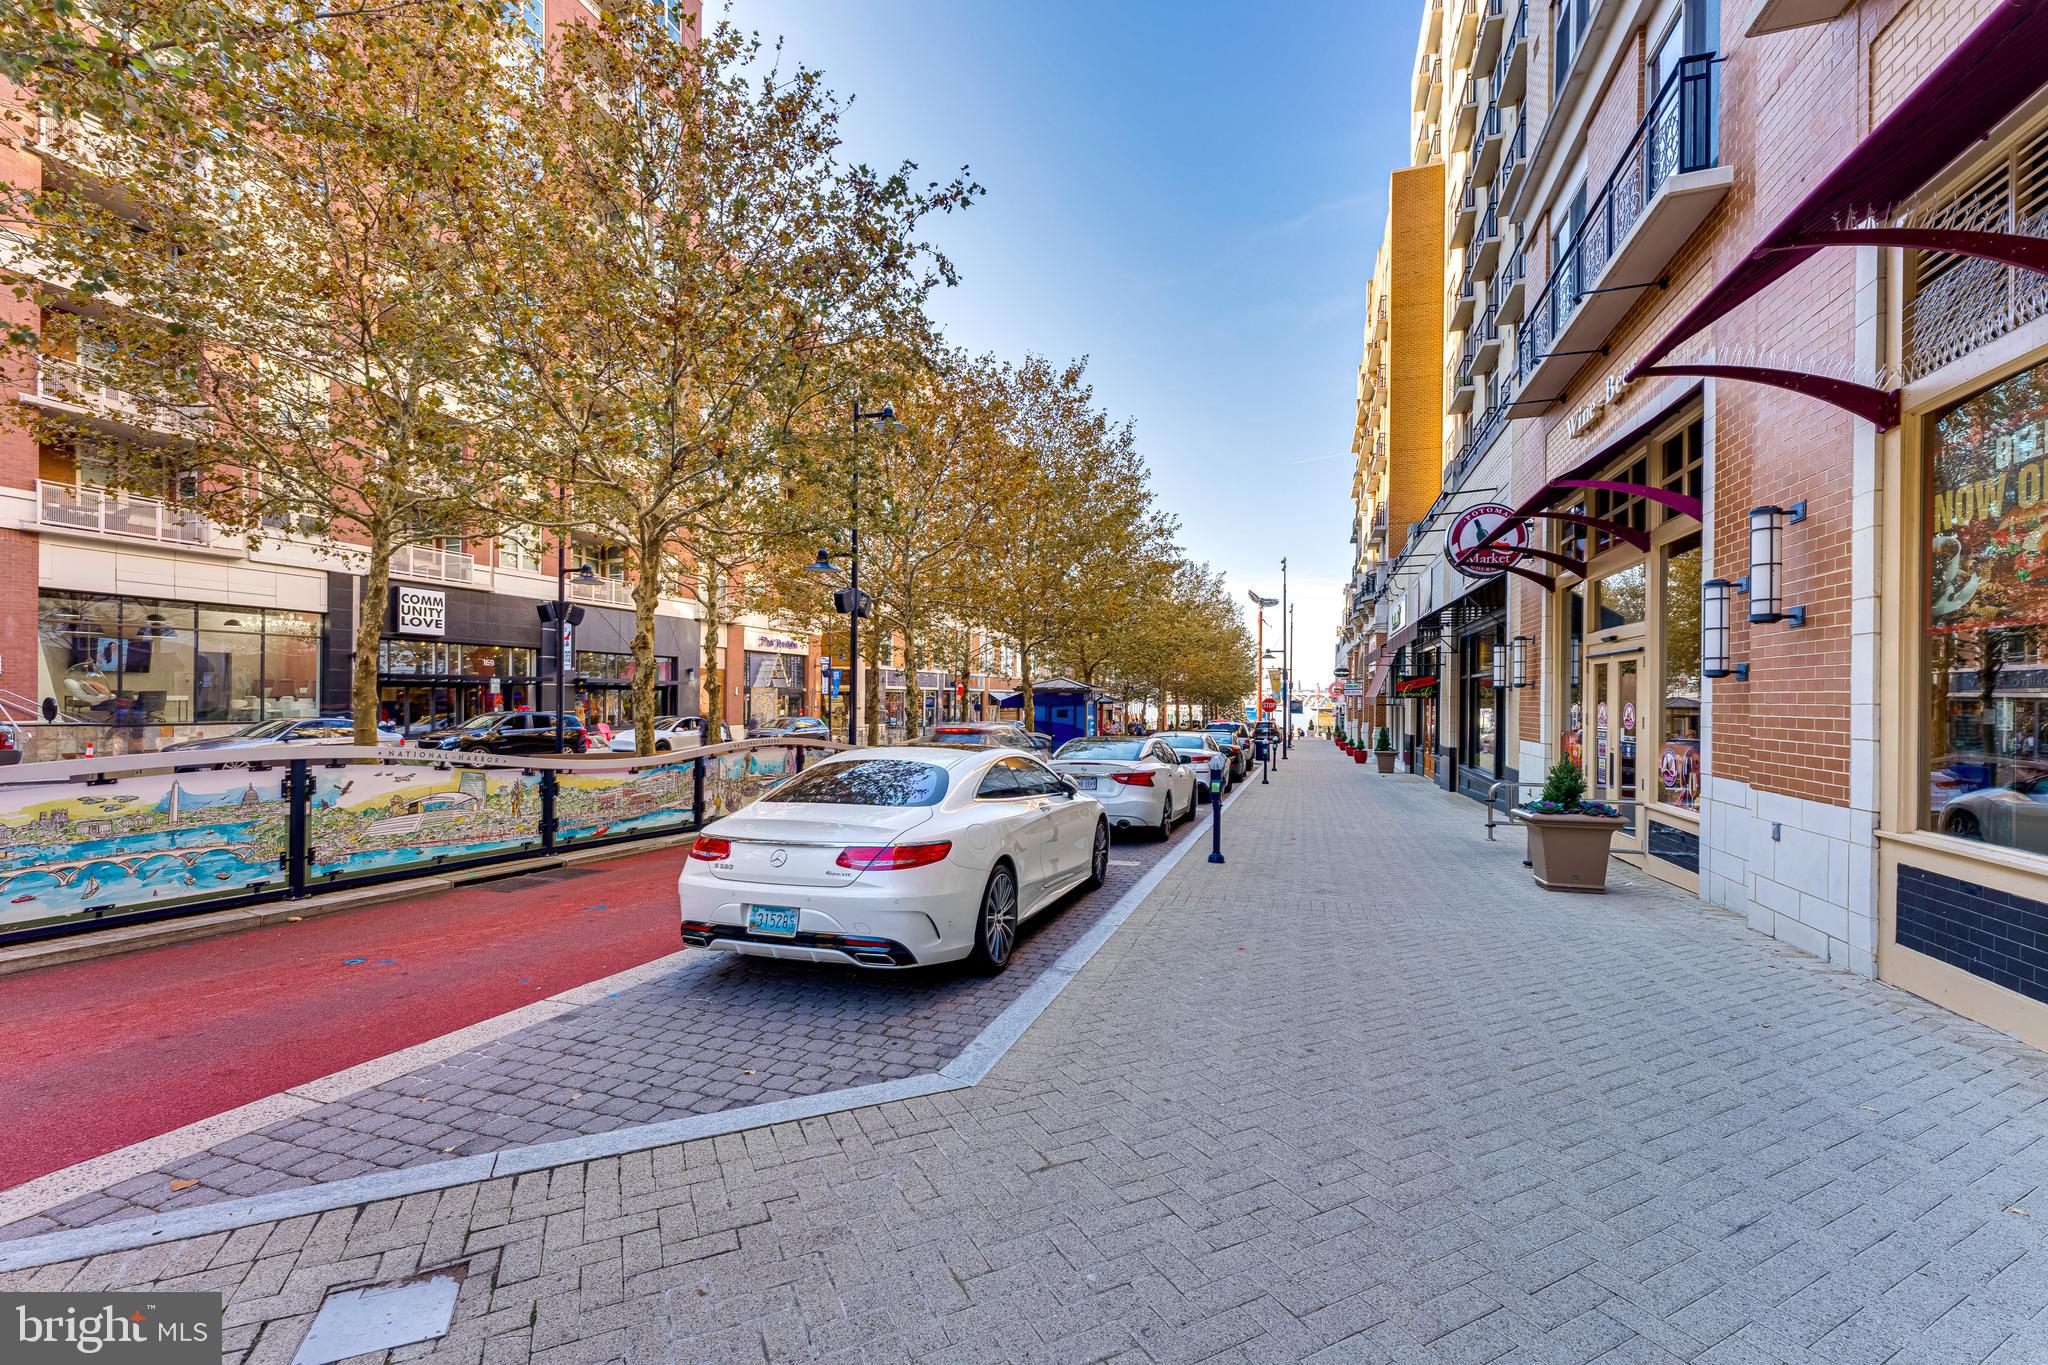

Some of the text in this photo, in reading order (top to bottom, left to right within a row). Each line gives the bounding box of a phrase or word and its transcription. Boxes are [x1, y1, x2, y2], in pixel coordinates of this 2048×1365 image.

[1567, 402, 1596, 439] Wine
[1935, 472, 2008, 533] NOW
[1465, 507, 1511, 521] POTOMA
[401, 593, 444, 608] COMM
[401, 604, 443, 618] UNITY
[401, 617, 443, 629] LOVE
[482, 658, 495, 667] 169
[388, 750, 500, 764] NATIONAL HARBOR
